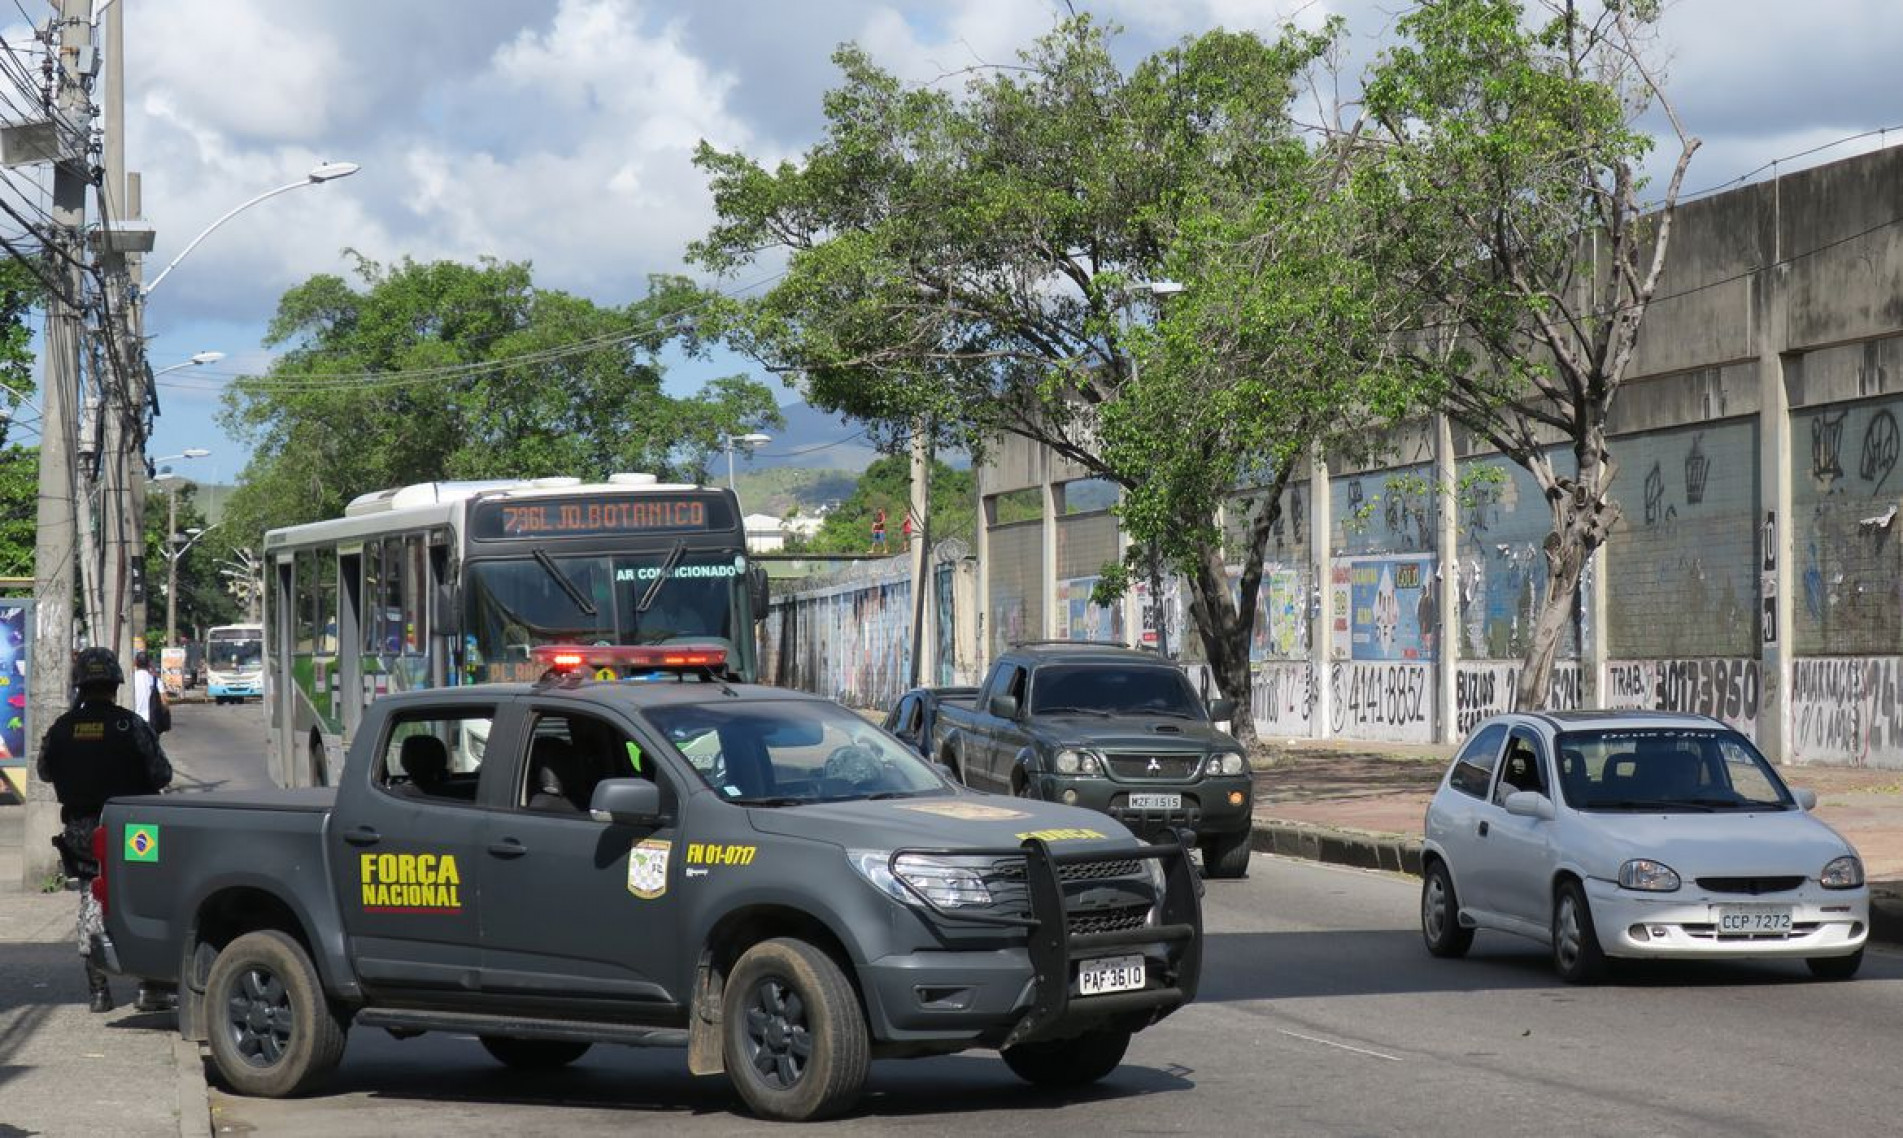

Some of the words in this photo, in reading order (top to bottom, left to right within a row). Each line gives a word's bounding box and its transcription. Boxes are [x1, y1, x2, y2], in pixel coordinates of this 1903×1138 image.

[588, 502, 704, 528] BOTANICO
[616, 569, 634, 581] AR
[638, 564, 736, 580] COICIONADO
[687, 843, 704, 863] FN
[361, 854, 459, 885] FORÇA
[362, 884, 461, 906] NACIONAL
